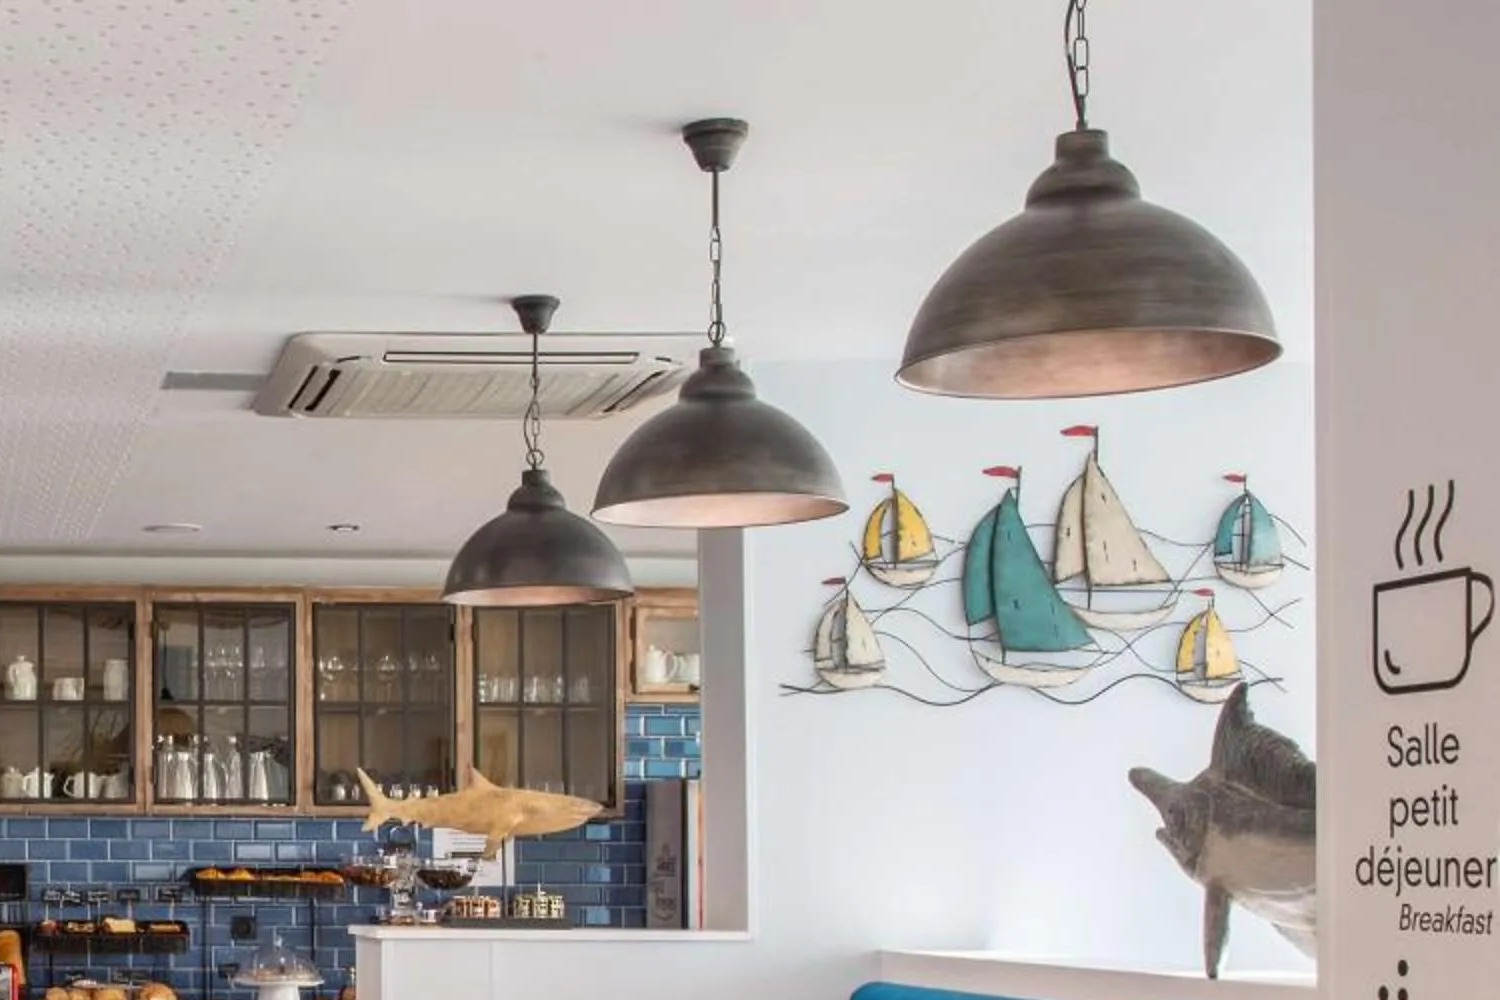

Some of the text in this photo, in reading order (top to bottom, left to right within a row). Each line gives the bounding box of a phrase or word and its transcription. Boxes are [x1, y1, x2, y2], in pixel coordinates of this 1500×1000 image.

[1387, 722, 1460, 768] Salle
[1389, 784, 1459, 839] petit
[1355, 845, 1498, 898] déjeuner
[1399, 903, 1493, 935] Breakfast
